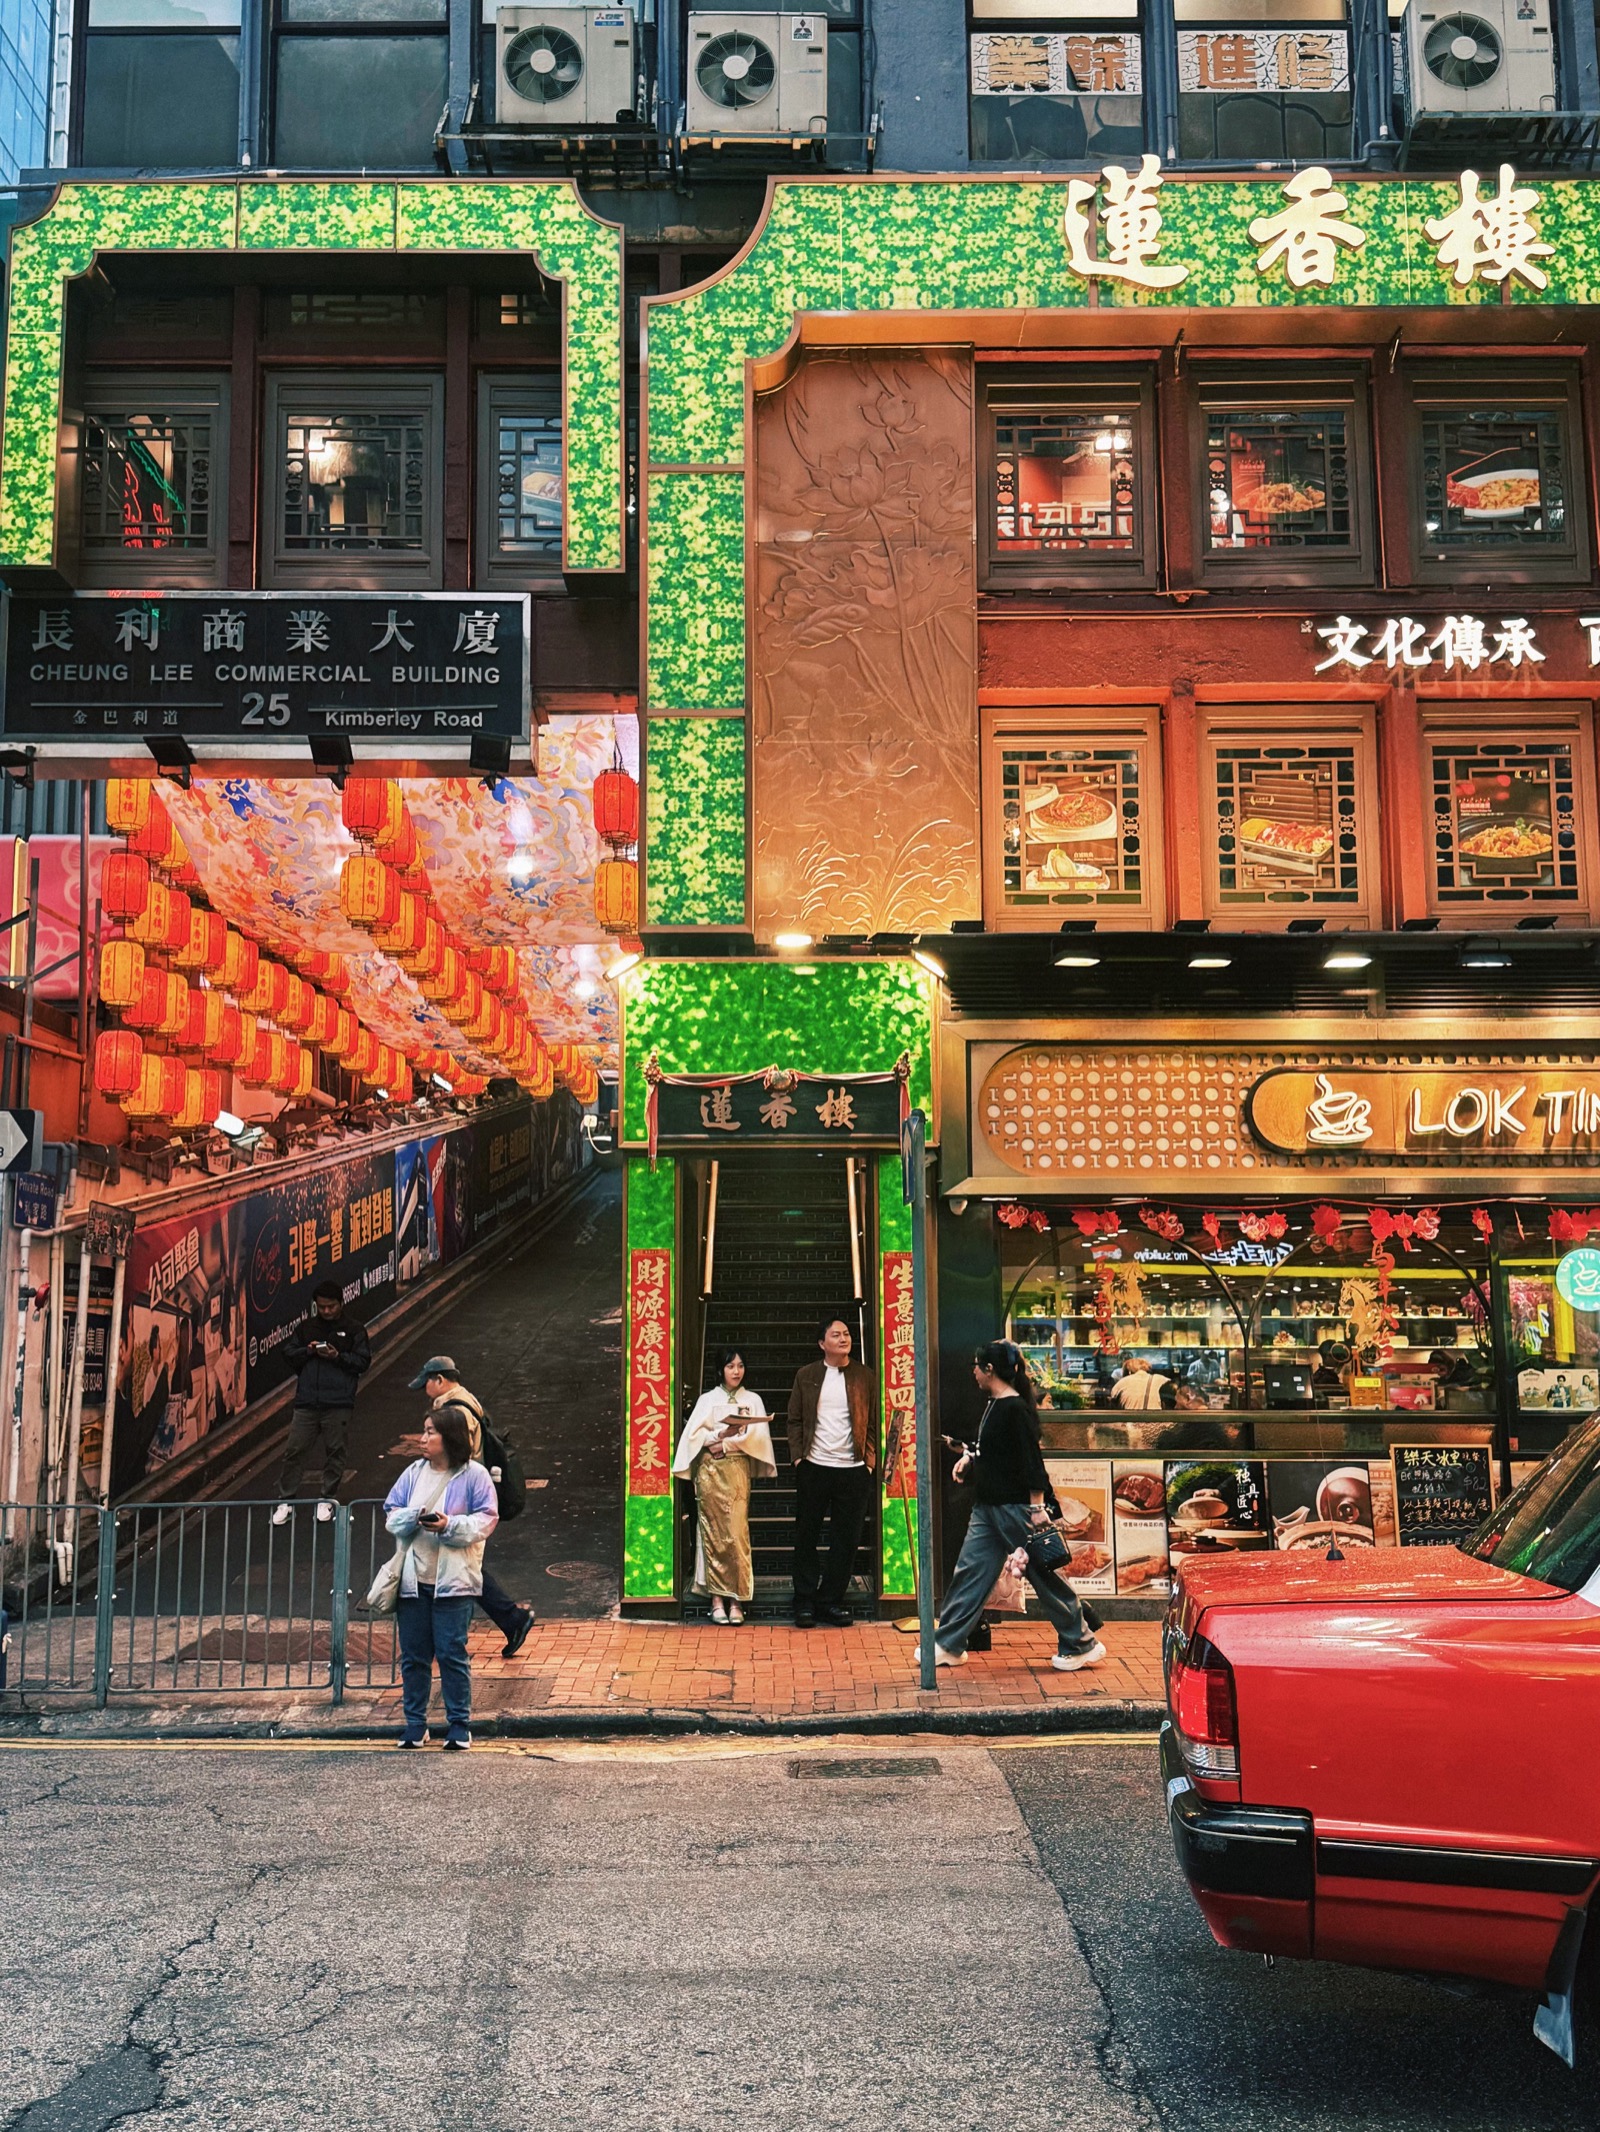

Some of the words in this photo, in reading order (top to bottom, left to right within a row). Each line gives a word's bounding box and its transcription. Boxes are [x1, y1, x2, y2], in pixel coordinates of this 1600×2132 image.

[1195, 33, 1334, 89] 進修
[1065, 153, 1555, 294] 蓮香樓
[31, 608, 501, 655] 長利商業大廈
[1313, 614, 1547, 674] 文化傳承
[30, 664, 129, 682] CHEUNG
[150, 664, 194, 682] LEE
[214, 664, 371, 683] COMMERCIAL
[391, 666, 501, 685] BUILDING
[72, 709, 179, 726] 金巴利道
[241, 692, 292, 726] 25
[324, 710, 423, 731] Kimberley
[433, 711, 483, 728] Road
[700, 1086, 858, 1131] 蓮香樓
[1409, 1085, 1527, 1137] LOK
[19, 1178, 39, 1195] Private
[40, 1183, 54, 1198] Road
[288, 1208, 343, 1285] 引擎一響
[349, 1186, 393, 1253] 派對登場
[149, 1226, 200, 1309] 公司聚會
[1403, 1449, 1463, 1467] 樂天冰室
[1235, 1468, 1260, 1520] 独具匠心
